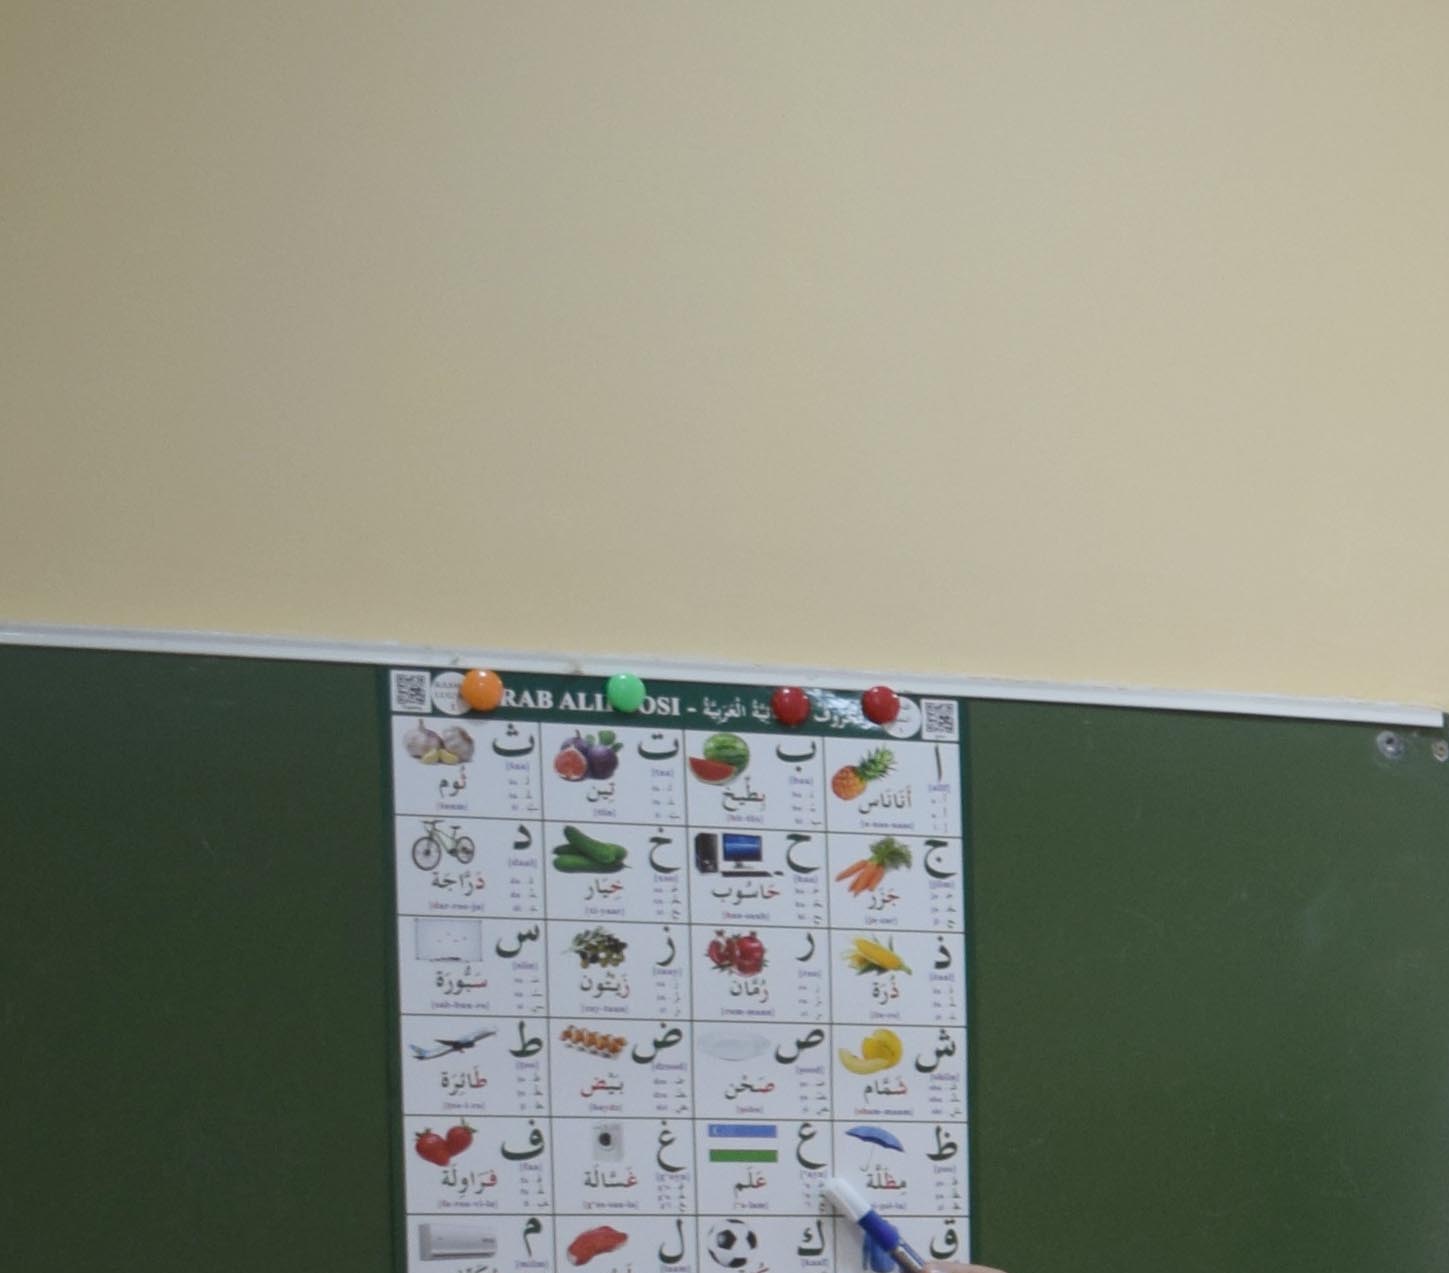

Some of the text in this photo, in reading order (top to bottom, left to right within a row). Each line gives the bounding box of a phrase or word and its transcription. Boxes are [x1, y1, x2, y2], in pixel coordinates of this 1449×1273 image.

[500, 687, 681, 716] RAB ALIOSI
[492, 723, 535, 758] ث
[638, 733, 680, 760] ت
[776, 741, 817, 773] ب
[935, 745, 943, 781] ا
[513, 825, 533, 850] د
[649, 827, 681, 873] خ
[786, 834, 820, 874] ح
[924, 840, 958, 879] ج
[495, 924, 540, 958] س
[656, 926, 676, 967] ز
[796, 932, 815, 962] ر
[934, 935, 952, 969] ذ
[508, 1020, 543, 1058] ط
[631, 1022, 683, 1064] ض
[775, 1029, 825, 1064] ص
[914, 1029, 957, 1073] ش
[501, 1119, 545, 1161] ف
[656, 1120, 687, 1173] غ
[796, 1122, 828, 1170] ع
[926, 1125, 958, 1161] ظ
[523, 1217, 543, 1258] م
[658, 1219, 685, 1263] ل
[797, 1219, 825, 1256] ك
[929, 1219, 959, 1260] ق
